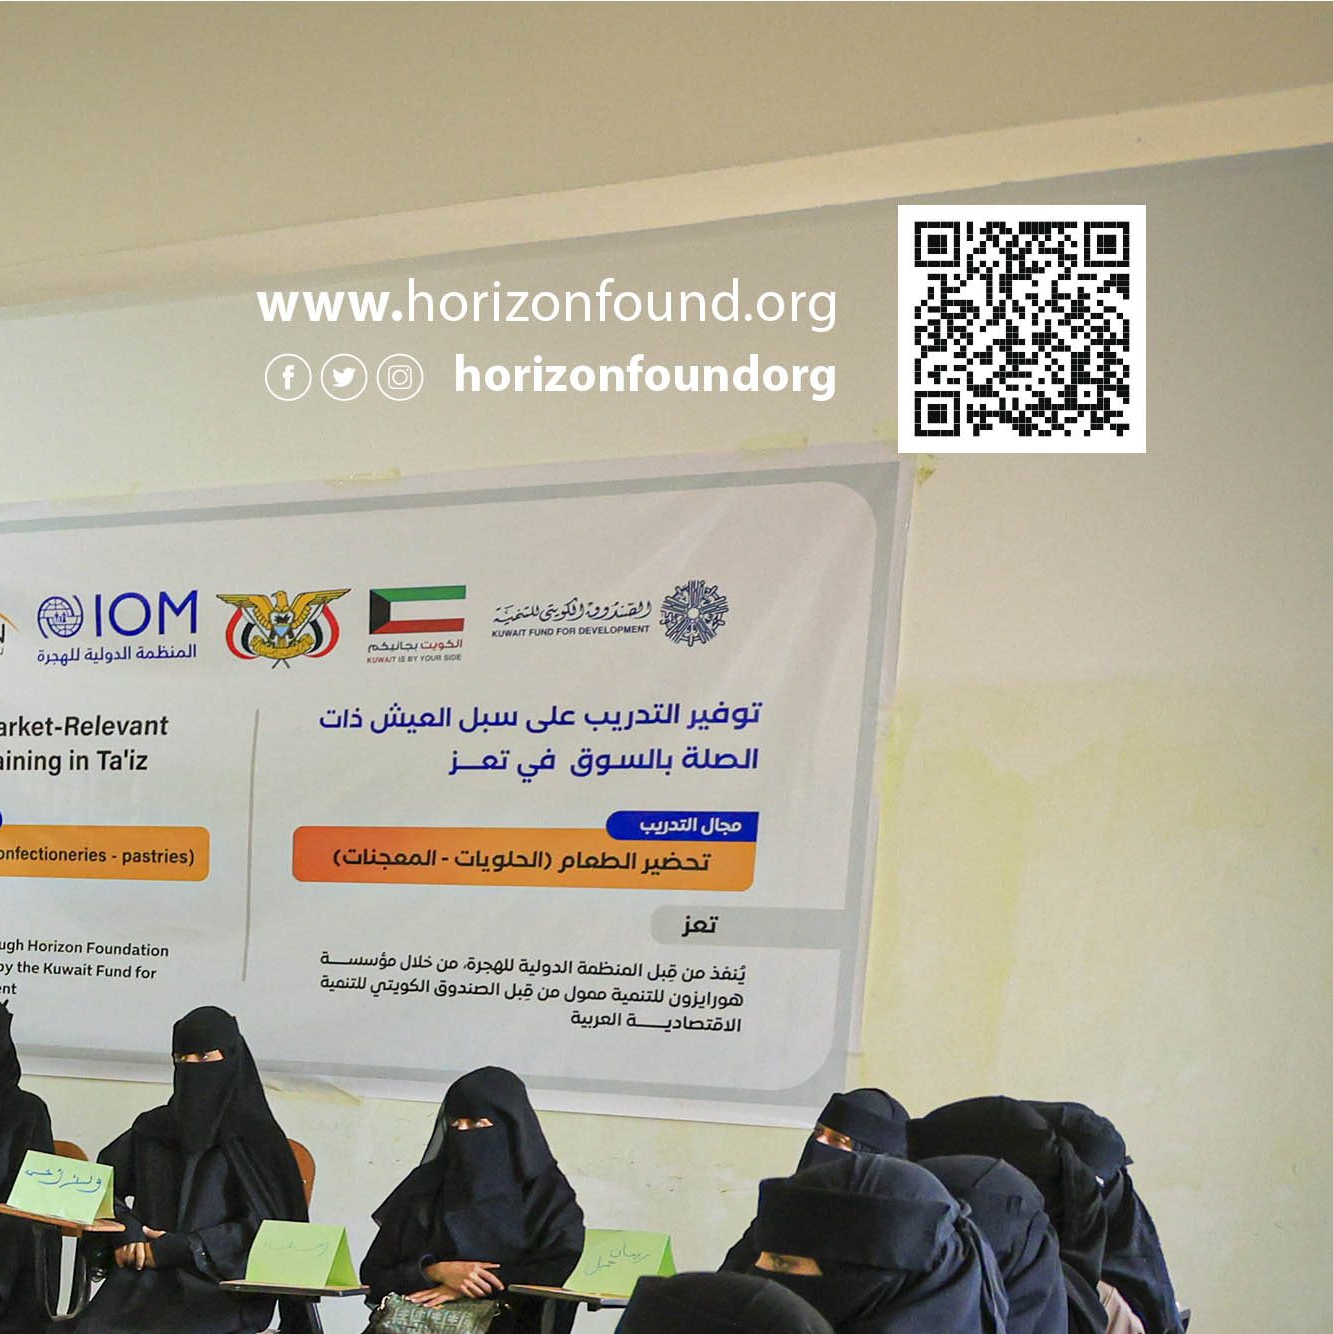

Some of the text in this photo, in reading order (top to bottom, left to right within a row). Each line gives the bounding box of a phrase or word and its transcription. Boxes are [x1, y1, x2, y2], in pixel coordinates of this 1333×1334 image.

[95, 590, 198, 637] IOM
[491, 625, 650, 638] KUWAIT FUND FOR DEVELOPMENT
[37, 643, 197, 666] المنظمة الدولية للهجرة
[367, 638, 463, 654] الكويت بجانبكم
[366, 653, 462, 664] KUWAIT IS BY YOUR SIDE
[319, 700, 764, 734] توفير التدريب على سبل العيش ذات
[69, 750, 90, 771] in
[96, 749, 149, 771] Ta'iz
[517, 749, 556, 783] في
[570, 747, 673, 776] بالسوق
[681, 745, 759, 771] الصلة
[639, 816, 743, 834] مجال التدريب
[121, 847, 195, 867] pastries)
[558, 851, 636, 874] الطعام
[641, 851, 712, 877] تحضير
[681, 914, 719, 938] تعز
[27, 938, 83, 955] Horizon
[86, 941, 170, 958] Foundation
[16, 960, 40, 975] the
[42, 962, 93, 977] Kuwait
[95, 964, 132, 979] Fund
[134, 966, 158, 980] for
[399, 953, 433, 971] خلال
[435, 956, 459, 972] من
[518, 958, 574, 978] الدولية
[576, 959, 643, 978] المنظمة
[319, 974, 367, 992] للتنمية
[681, 966, 706, 983] من
[369, 977, 431, 998] الكويتي
[433, 979, 501, 998] الصندوق
[536, 985, 561, 1002] من
[563, 985, 608, 1004] ممول
[611, 986, 665, 1005] للتنمية
[668, 990, 744, 1011] هورايزون
[570, 1010, 623, 1030] العربية
